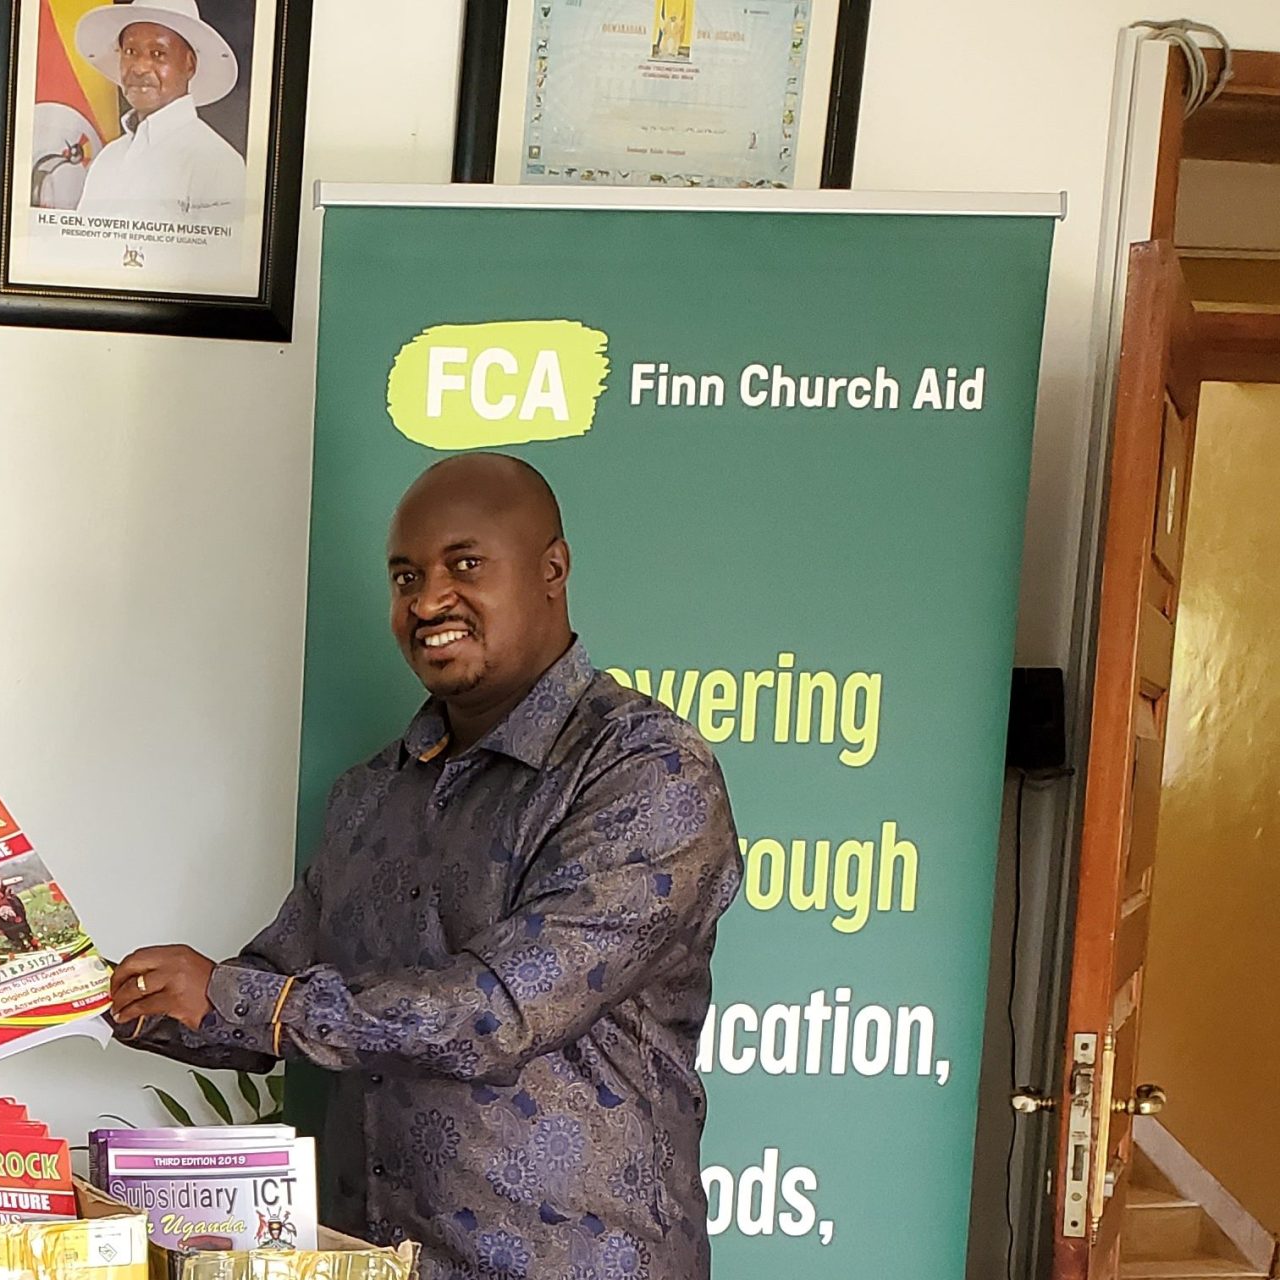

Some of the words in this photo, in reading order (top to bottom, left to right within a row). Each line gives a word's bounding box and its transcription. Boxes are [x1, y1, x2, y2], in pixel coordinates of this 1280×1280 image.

[38, 214, 57, 225] H.E.
[60, 215, 85, 227] GEN.
[87, 217, 130, 230] YOWERI
[132, 221, 175, 233] KAGUTA
[177, 224, 232, 237] MUSEVENI
[61, 228, 101, 238] PRESIDENT
[102, 231, 112, 239] OF
[113, 232, 128, 240] THE
[129, 233, 164, 243] REPUBLIC
[176, 237, 207, 245] UGANDA
[425, 346, 570, 422] FCA
[630, 363, 725, 406] Finn
[740, 364, 899, 408] Church
[912, 367, 985, 410] Aid
[739, 822, 919, 934] ough
[3, 1006, 14, 1014] on
[154, 1157, 180, 1166] THIRD
[181, 1157, 217, 1166] EDITION
[109, 1180, 238, 1214] Subsidiary
[252, 1177, 297, 1207] ICT
[161, 1214, 247, 1241] Uganda
